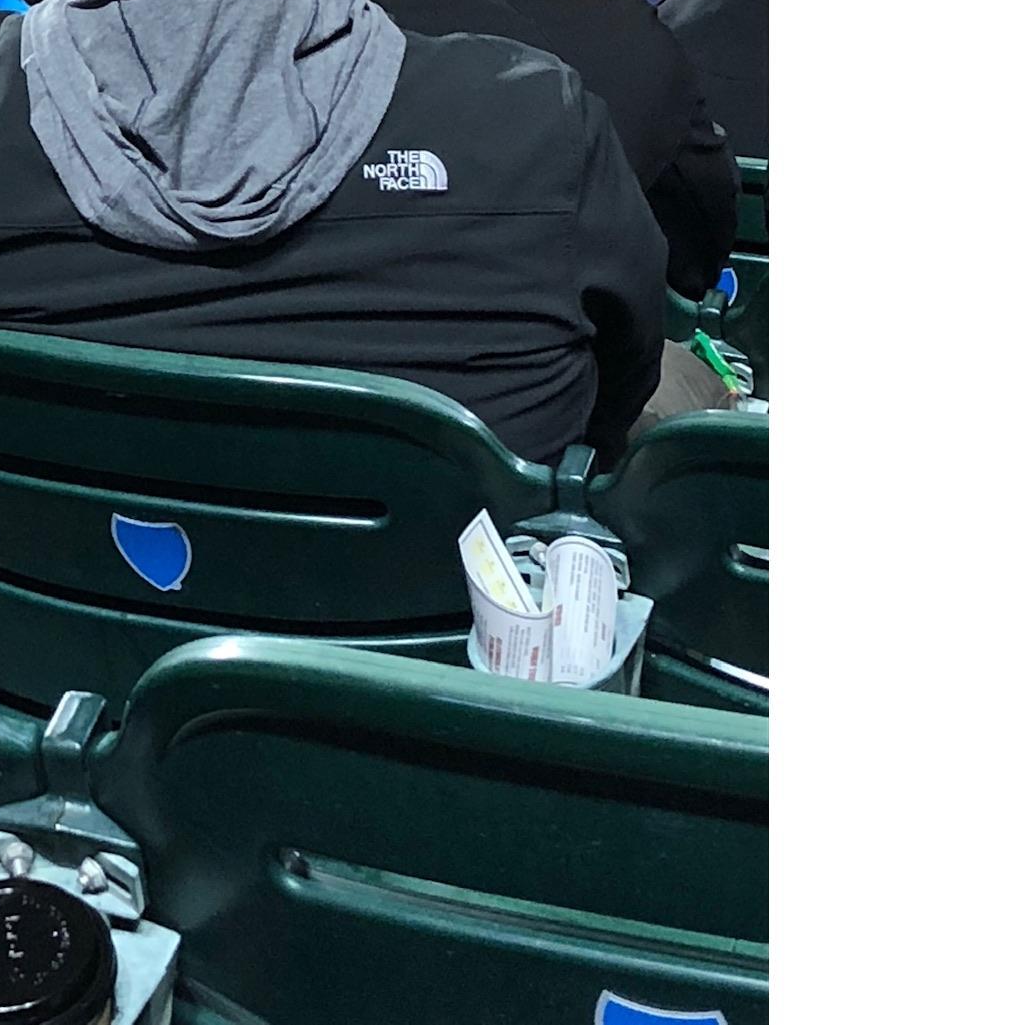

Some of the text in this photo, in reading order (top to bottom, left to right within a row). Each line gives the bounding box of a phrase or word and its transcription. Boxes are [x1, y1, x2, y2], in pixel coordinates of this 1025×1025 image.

[387, 150, 420, 164] THE
[362, 163, 420, 179] NORTH
[379, 176, 420, 191] FACE
